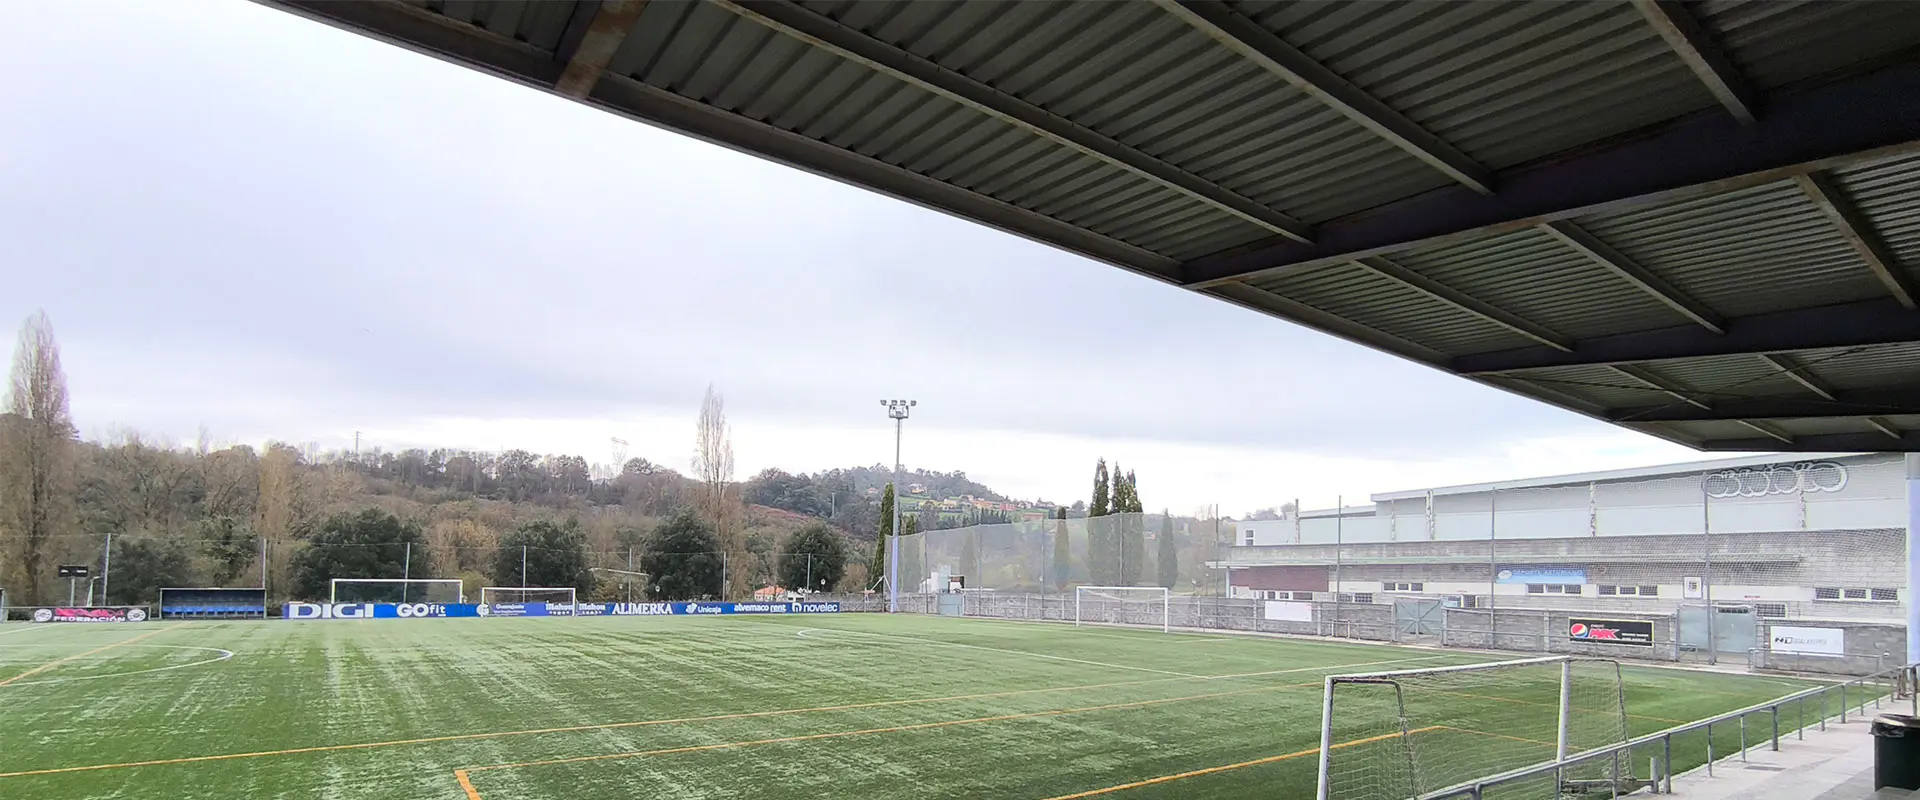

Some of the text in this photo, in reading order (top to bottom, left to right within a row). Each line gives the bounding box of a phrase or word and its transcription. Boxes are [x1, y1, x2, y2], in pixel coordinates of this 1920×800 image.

[289, 603, 374, 618] DIGI
[612, 602, 673, 615] ALIMERKA
[697, 605, 722, 614] Unicaja
[733, 603, 787, 613] alvemaco rent
[803, 602, 838, 612] novelec
